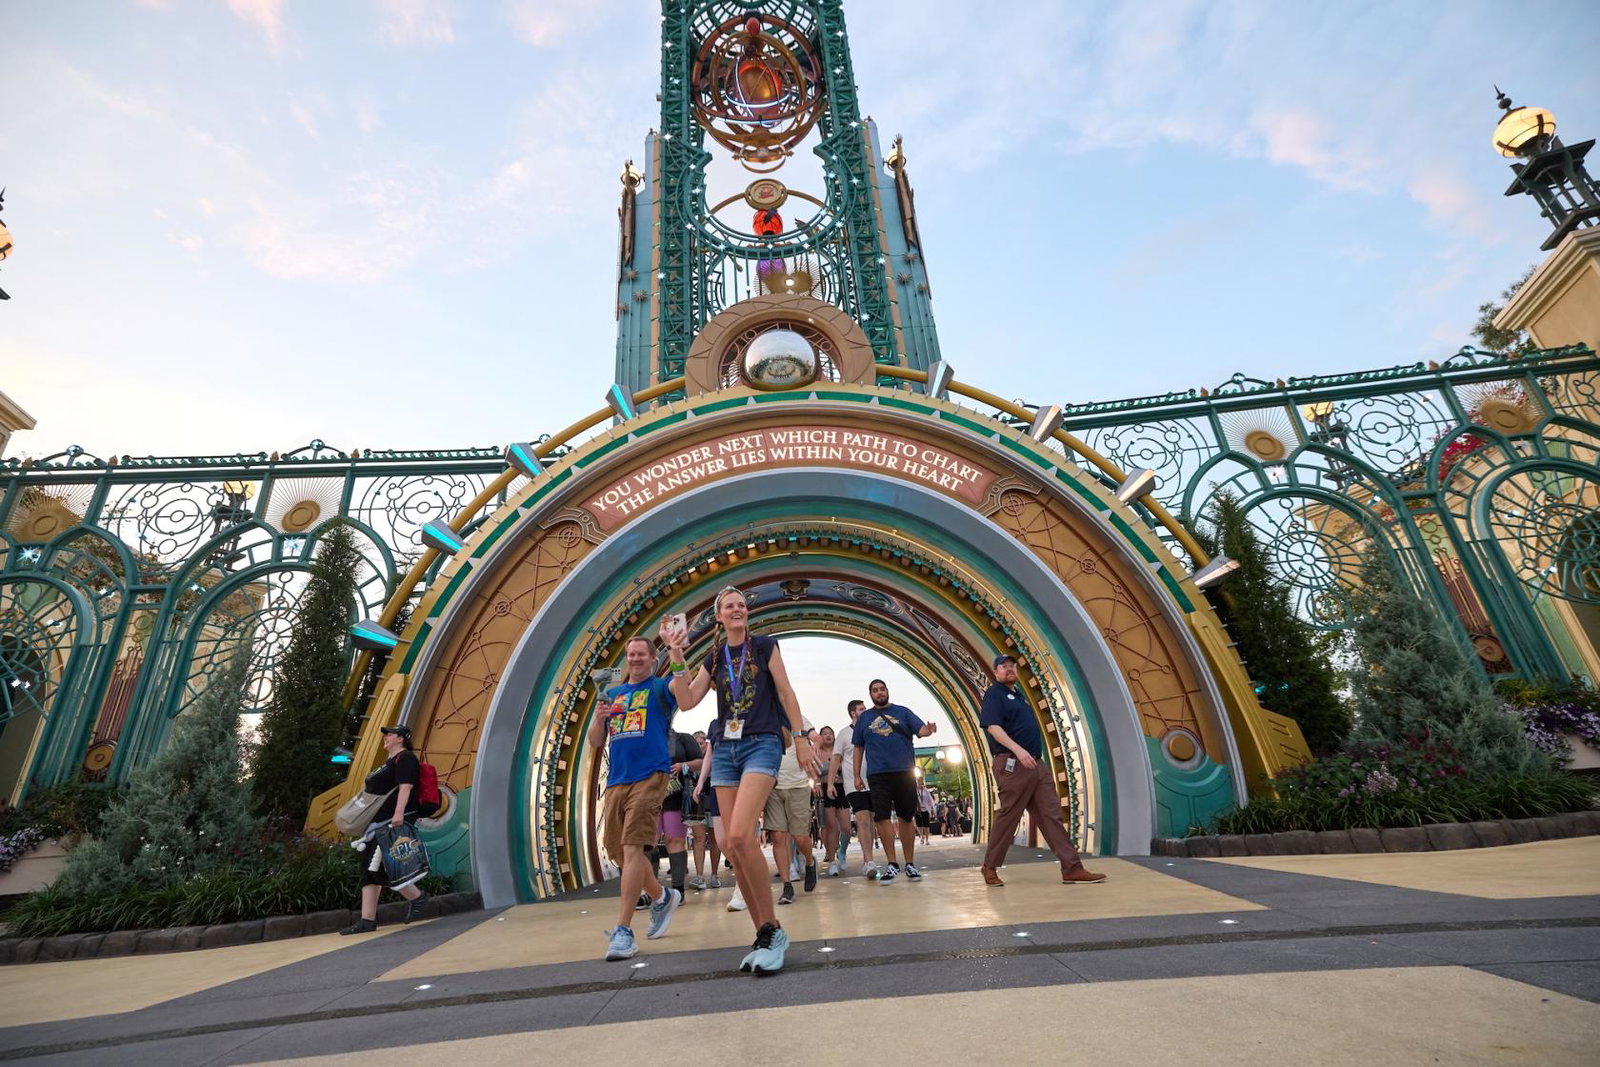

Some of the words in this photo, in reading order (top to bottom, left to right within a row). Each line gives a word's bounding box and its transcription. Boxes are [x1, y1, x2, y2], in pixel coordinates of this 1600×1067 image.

[592, 482, 630, 511] YOU
[634, 447, 713, 486] WONDER
[718, 434, 763, 455] NEXT
[769, 430, 836, 444] WHICH
[842, 432, 888, 450] PATH
[893, 440, 917, 457] TO
[921, 450, 983, 483] CHART
[616, 487, 654, 515] THE
[657, 459, 727, 496] ANSWER
[731, 450, 766, 468] LIES
[769, 446, 842, 460] WITHIN
[848, 448, 897, 469] YOUR
[903, 460, 963, 491] HEART
[389, 839, 419, 856] EPIC
